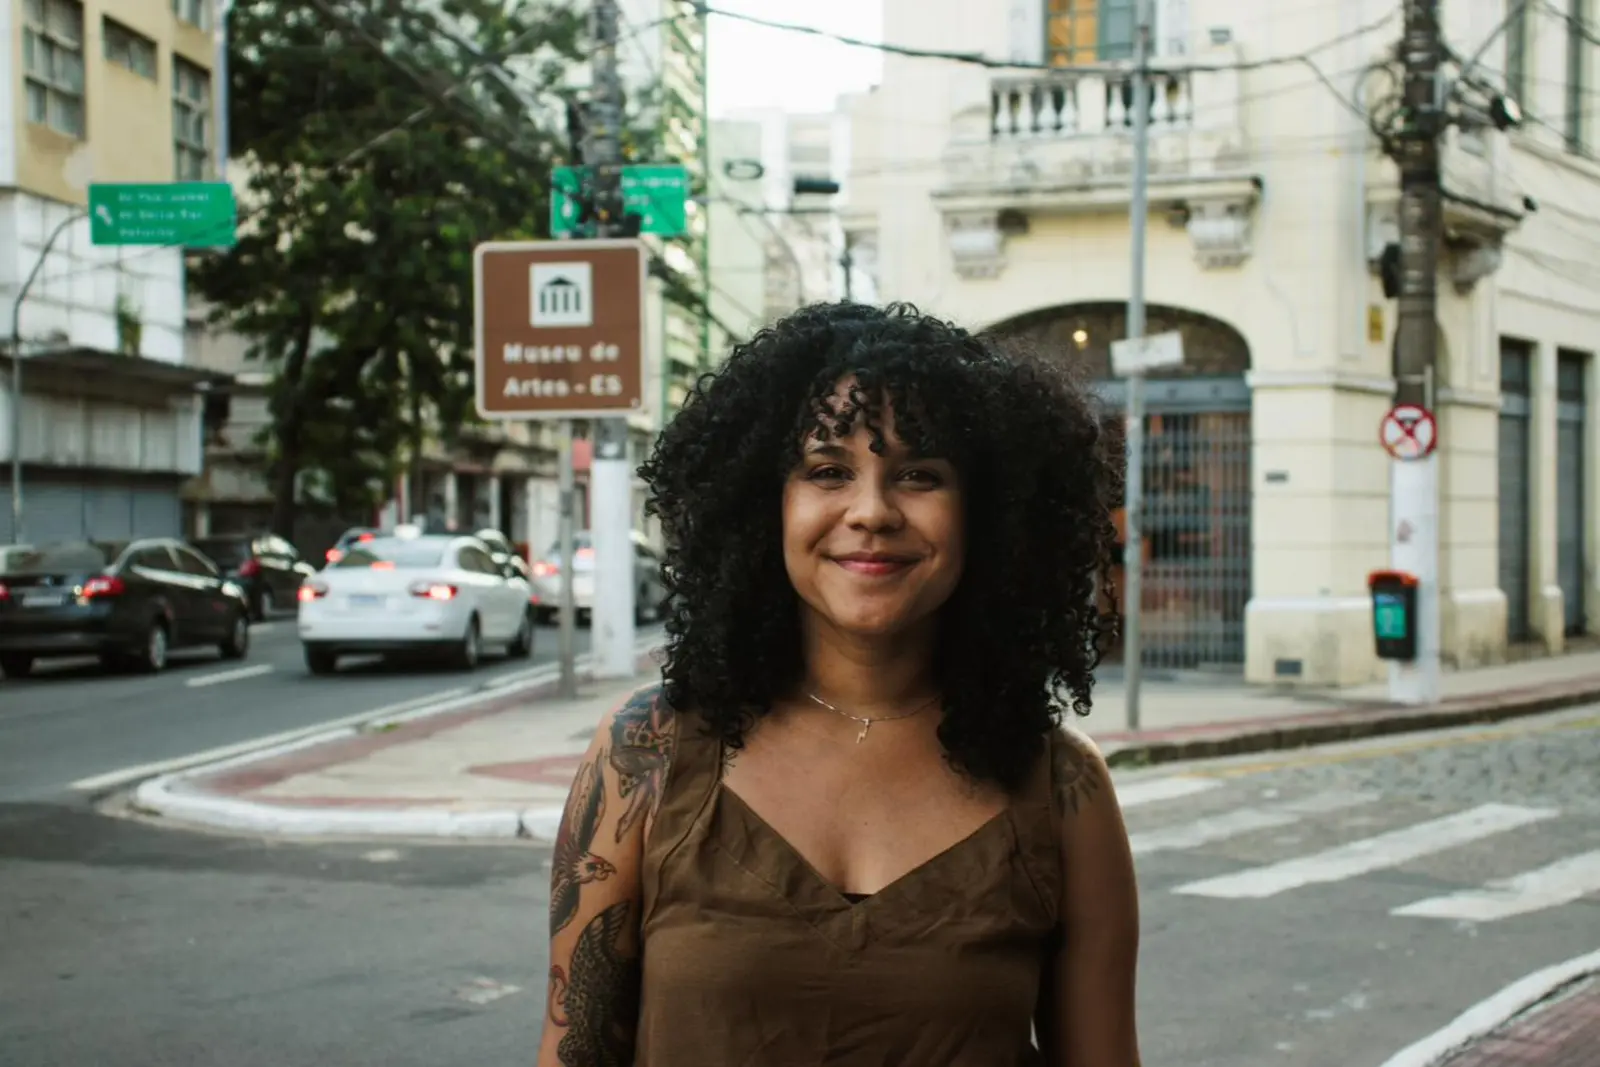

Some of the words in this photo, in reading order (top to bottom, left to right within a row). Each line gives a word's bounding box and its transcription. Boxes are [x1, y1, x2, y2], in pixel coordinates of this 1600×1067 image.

[503, 342, 582, 363] Museu
[590, 340, 620, 362] de
[503, 376, 570, 397] Artes
[573, 382, 587, 394] -
[590, 374, 622, 396] ES
